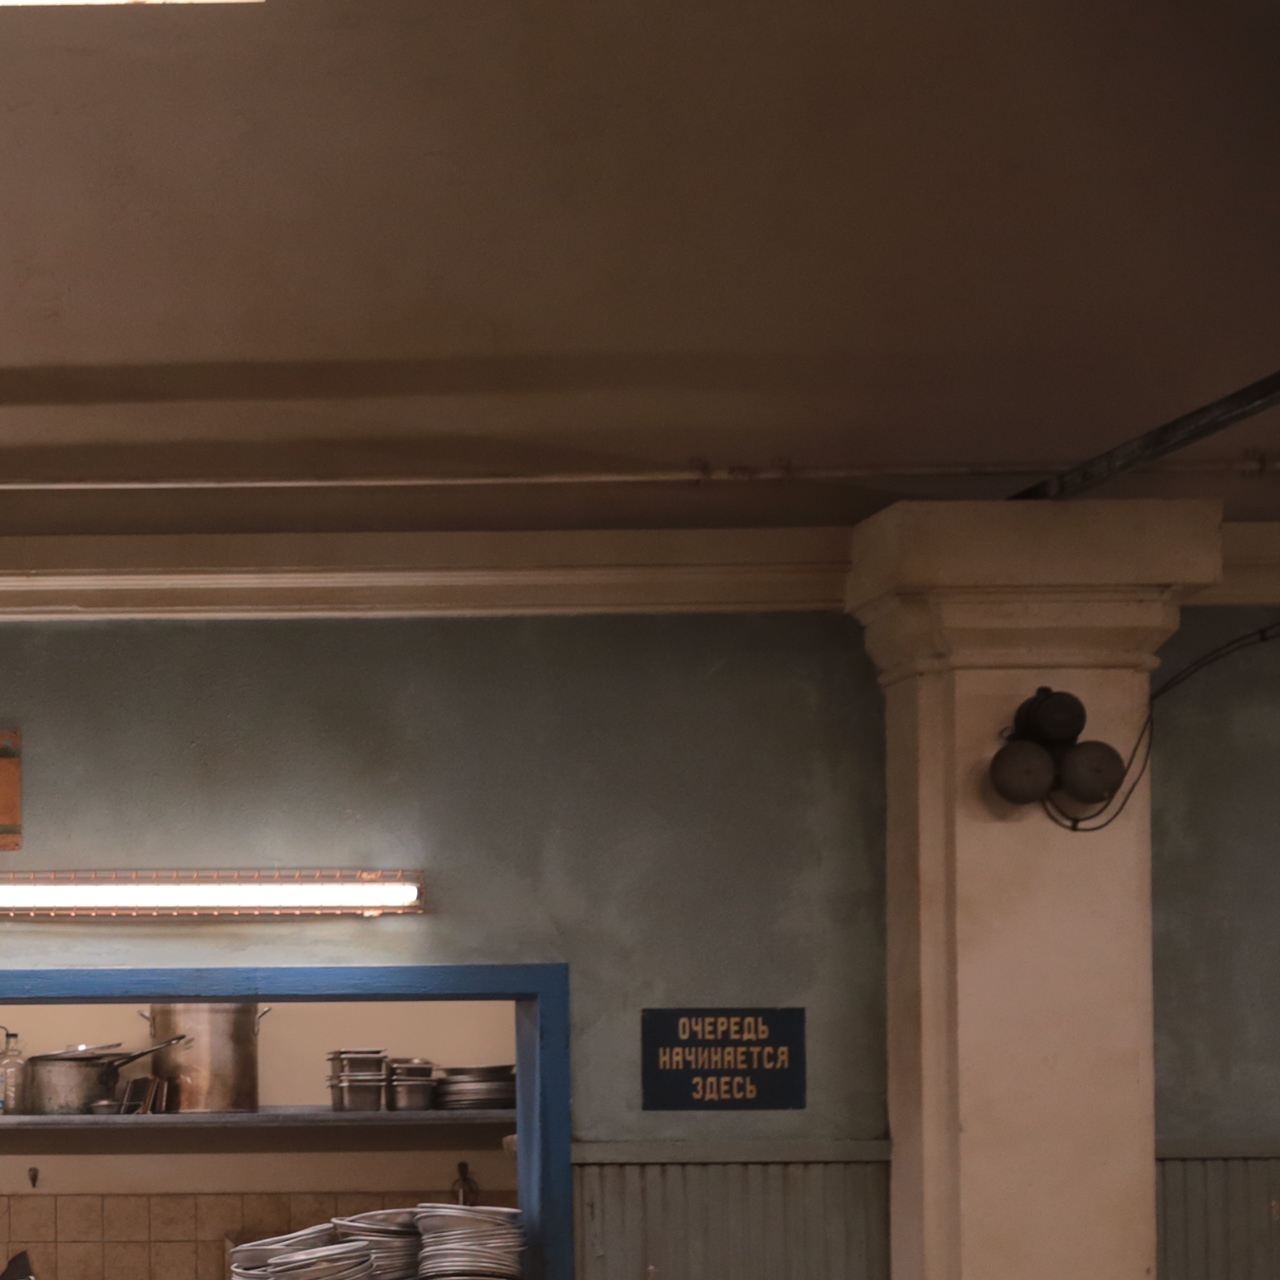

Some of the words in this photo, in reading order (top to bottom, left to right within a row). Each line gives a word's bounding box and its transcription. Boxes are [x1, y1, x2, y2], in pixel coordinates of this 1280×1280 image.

[678, 1016, 770, 1041] ОЧЕРЕДЬ
[658, 1046, 790, 1070] НАЧИНАЕТСЯ
[691, 1076, 758, 1101] ЗДЕСЬ
